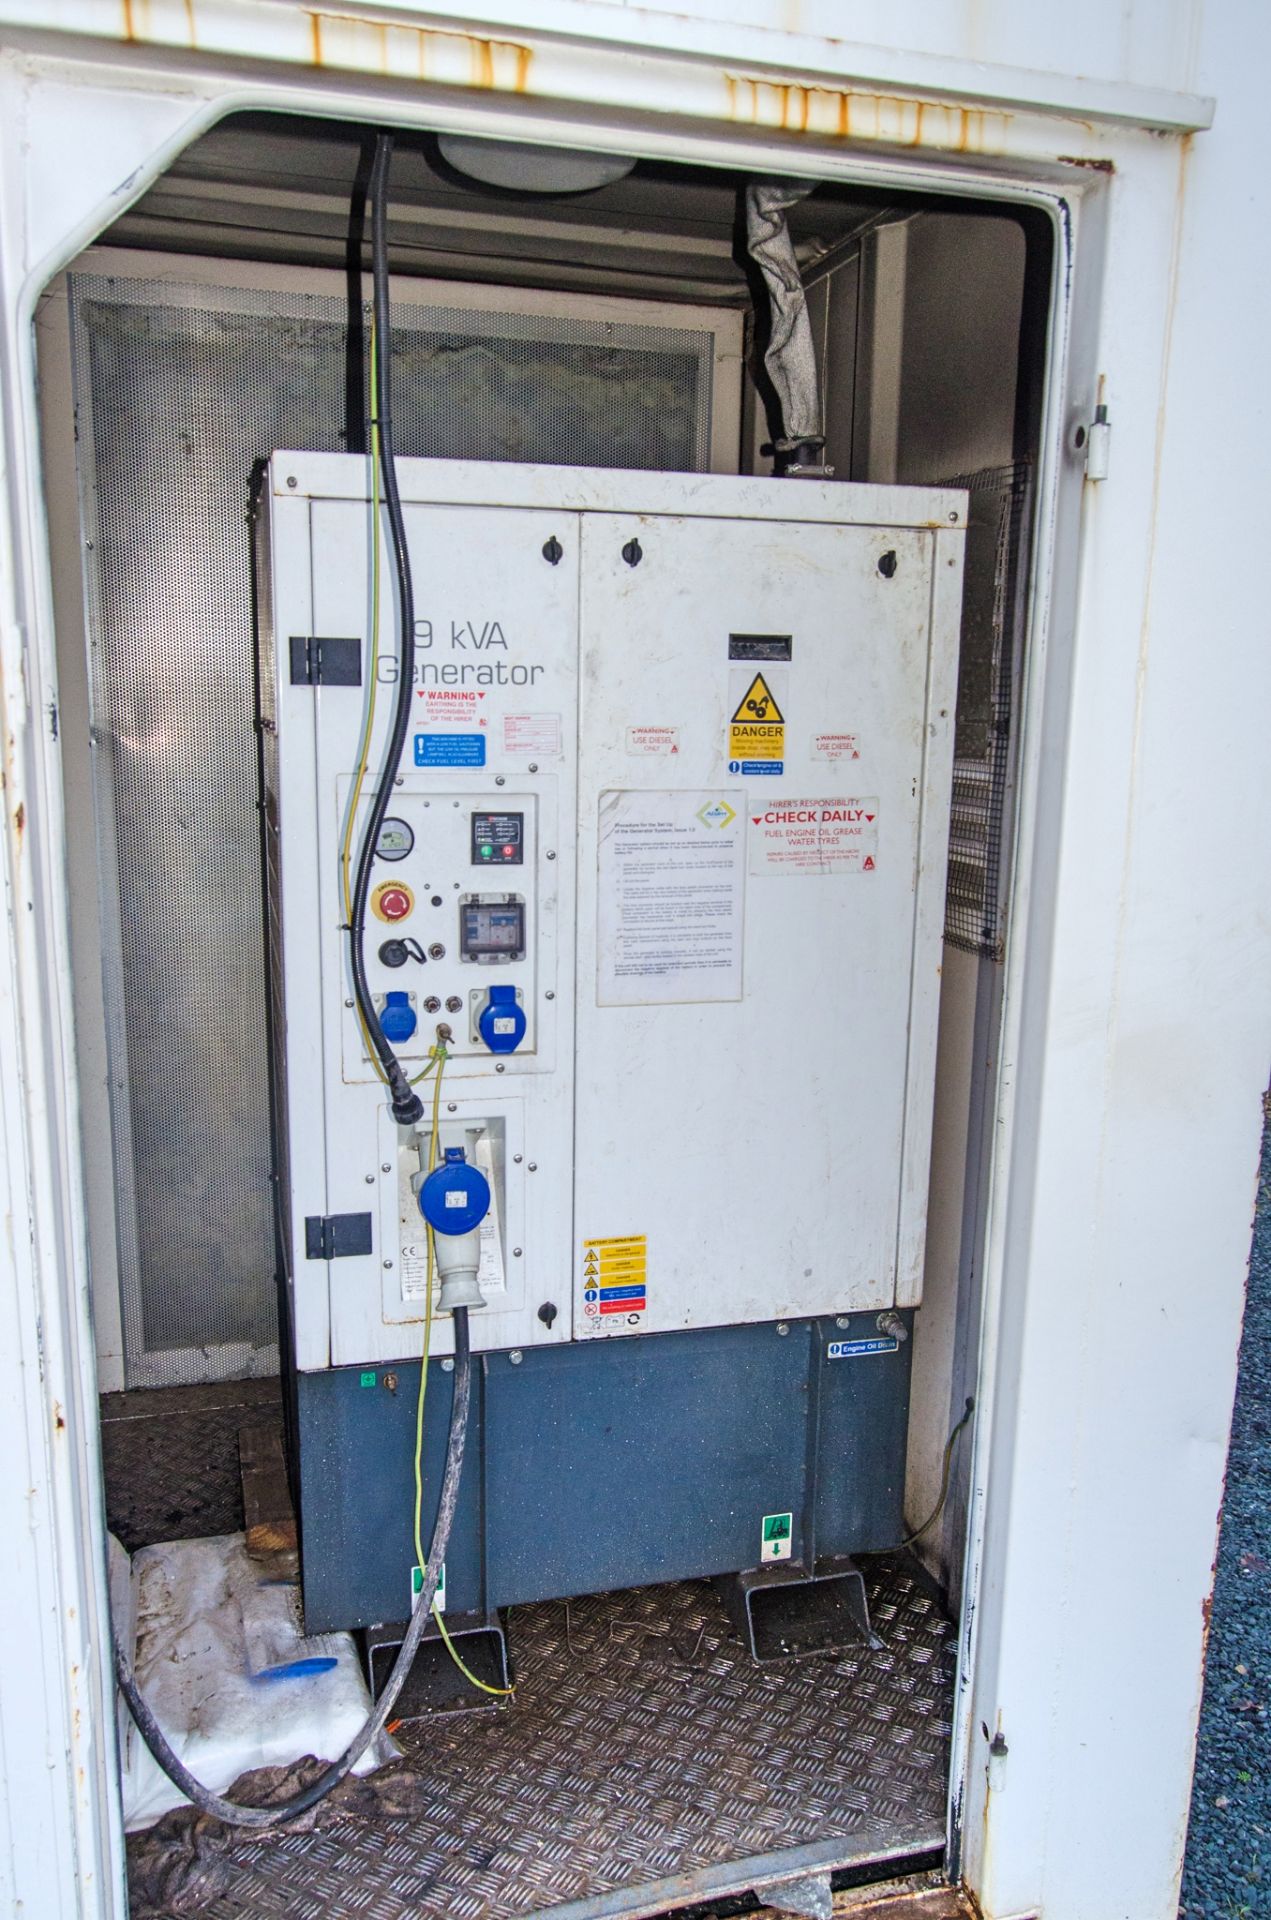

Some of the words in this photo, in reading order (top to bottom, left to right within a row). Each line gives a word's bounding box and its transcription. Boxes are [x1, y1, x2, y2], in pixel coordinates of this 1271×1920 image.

[414, 620, 433, 649] 9
[451, 620, 508, 650] kVA
[428, 691, 476, 700] WARNING
[732, 726, 783, 736] DANGER
[800, 799, 860, 808] RESPONSIBILITY
[764, 811, 818, 824] CHECK
[822, 810, 864, 822] DAILY
[786, 828, 816, 837] ENGINE
[818, 828, 832, 836] OIL
[833, 827, 863, 836] GREASE
[816, 837, 840, 845] TYRES
[843, 1345, 866, 1353] Engine
